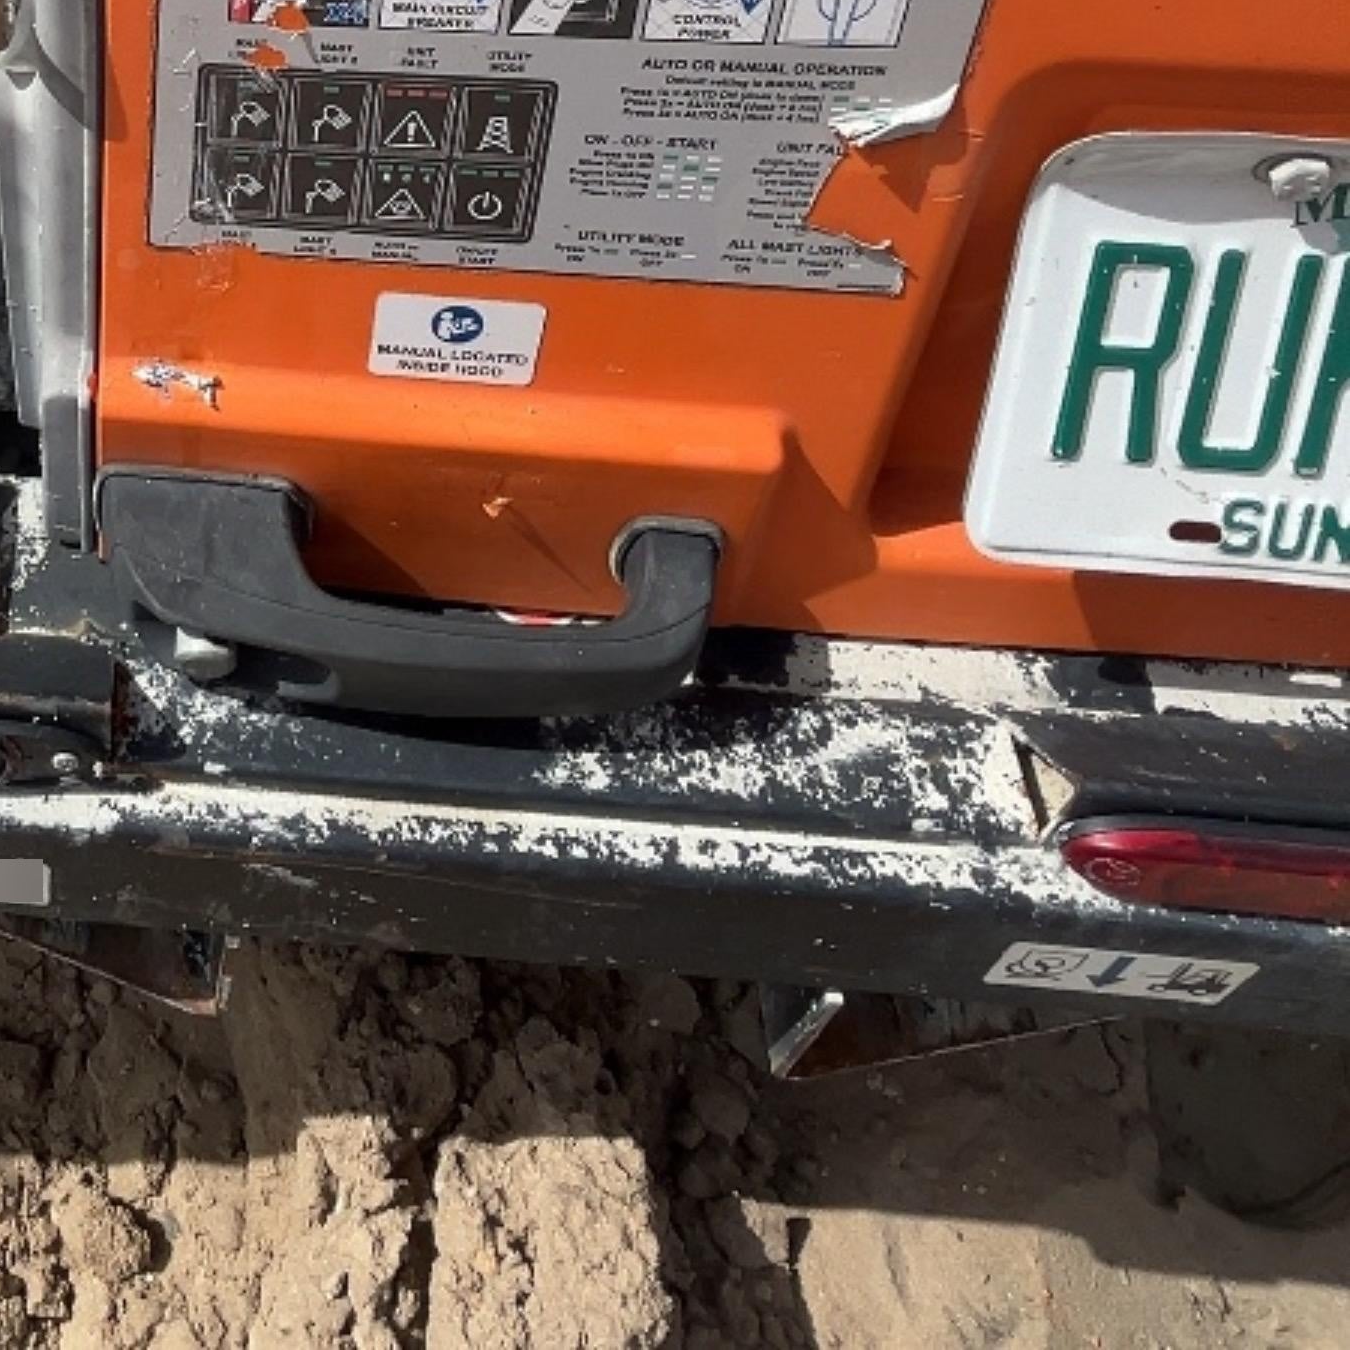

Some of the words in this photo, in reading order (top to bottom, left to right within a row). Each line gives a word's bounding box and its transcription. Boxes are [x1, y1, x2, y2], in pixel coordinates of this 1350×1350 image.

[641, 58, 688, 71] AUTO
[719, 60, 786, 75] MANUAL
[793, 63, 889, 77] OPERATION
[377, 345, 447, 360] MANUAL
[451, 350, 528, 366] LOCATED
